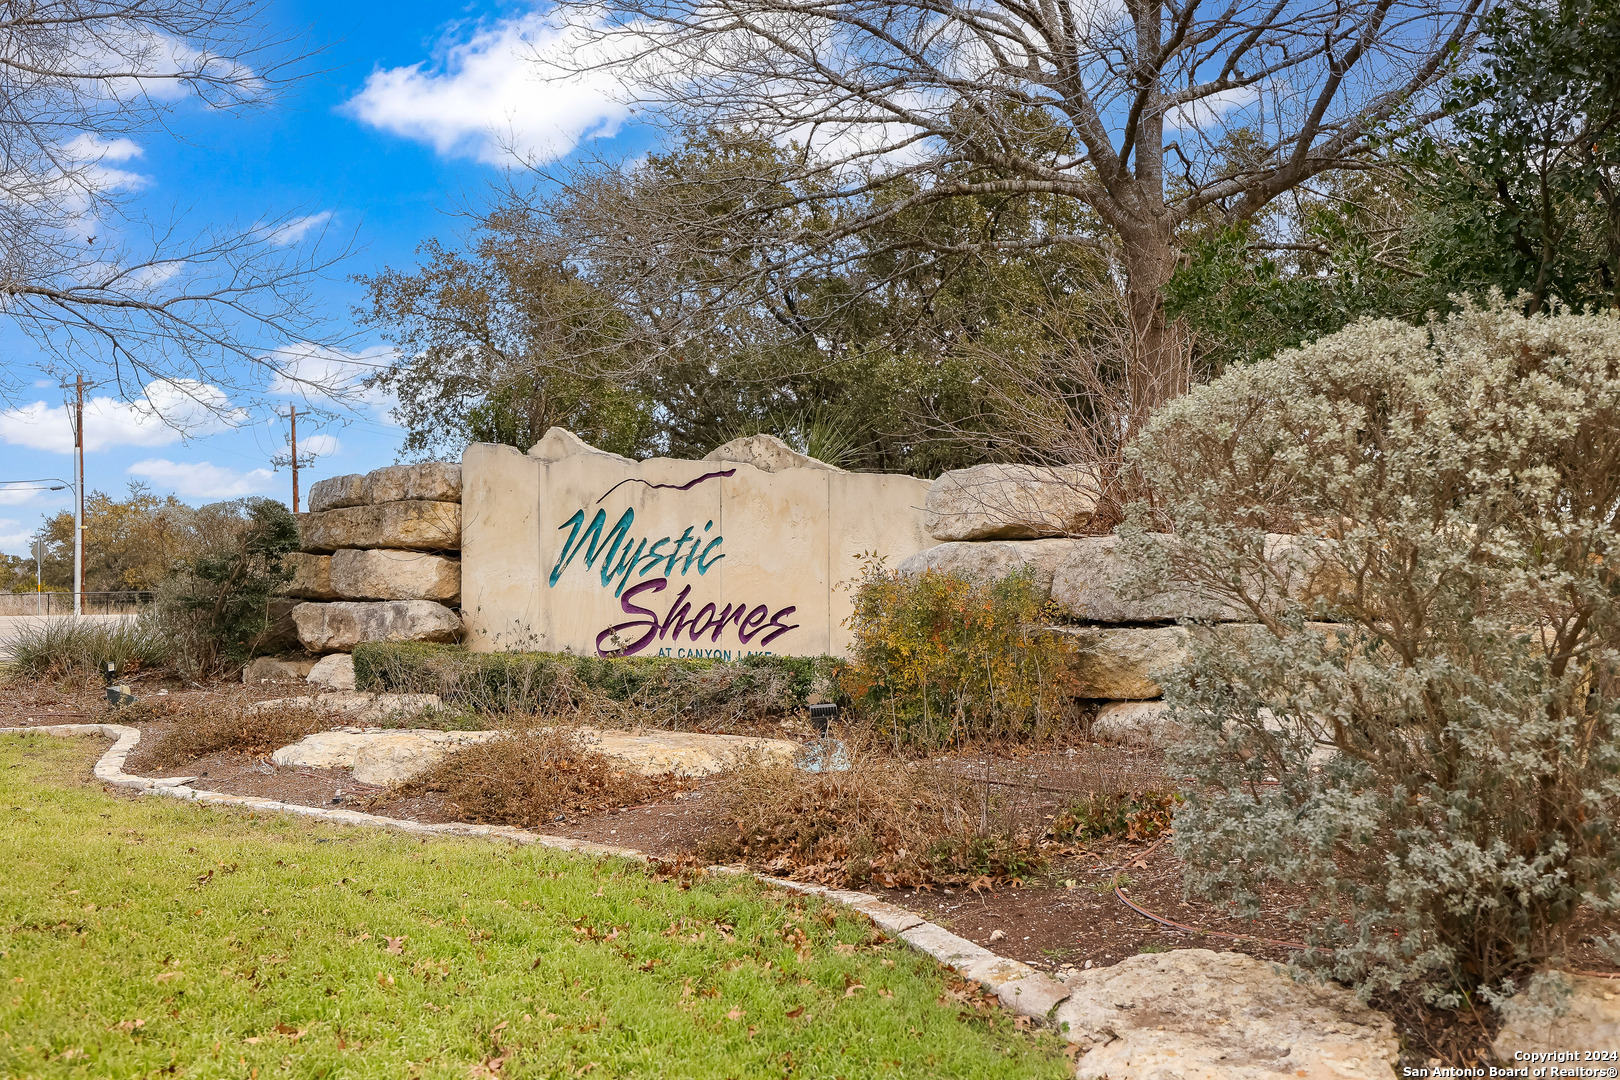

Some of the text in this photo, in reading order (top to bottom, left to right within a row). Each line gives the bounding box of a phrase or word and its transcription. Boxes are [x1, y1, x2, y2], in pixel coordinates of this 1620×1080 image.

[549, 506, 726, 598] Mystic
[596, 577, 800, 658] Shores
[658, 647, 672, 657] AT
[677, 648, 732, 661] CANYON
